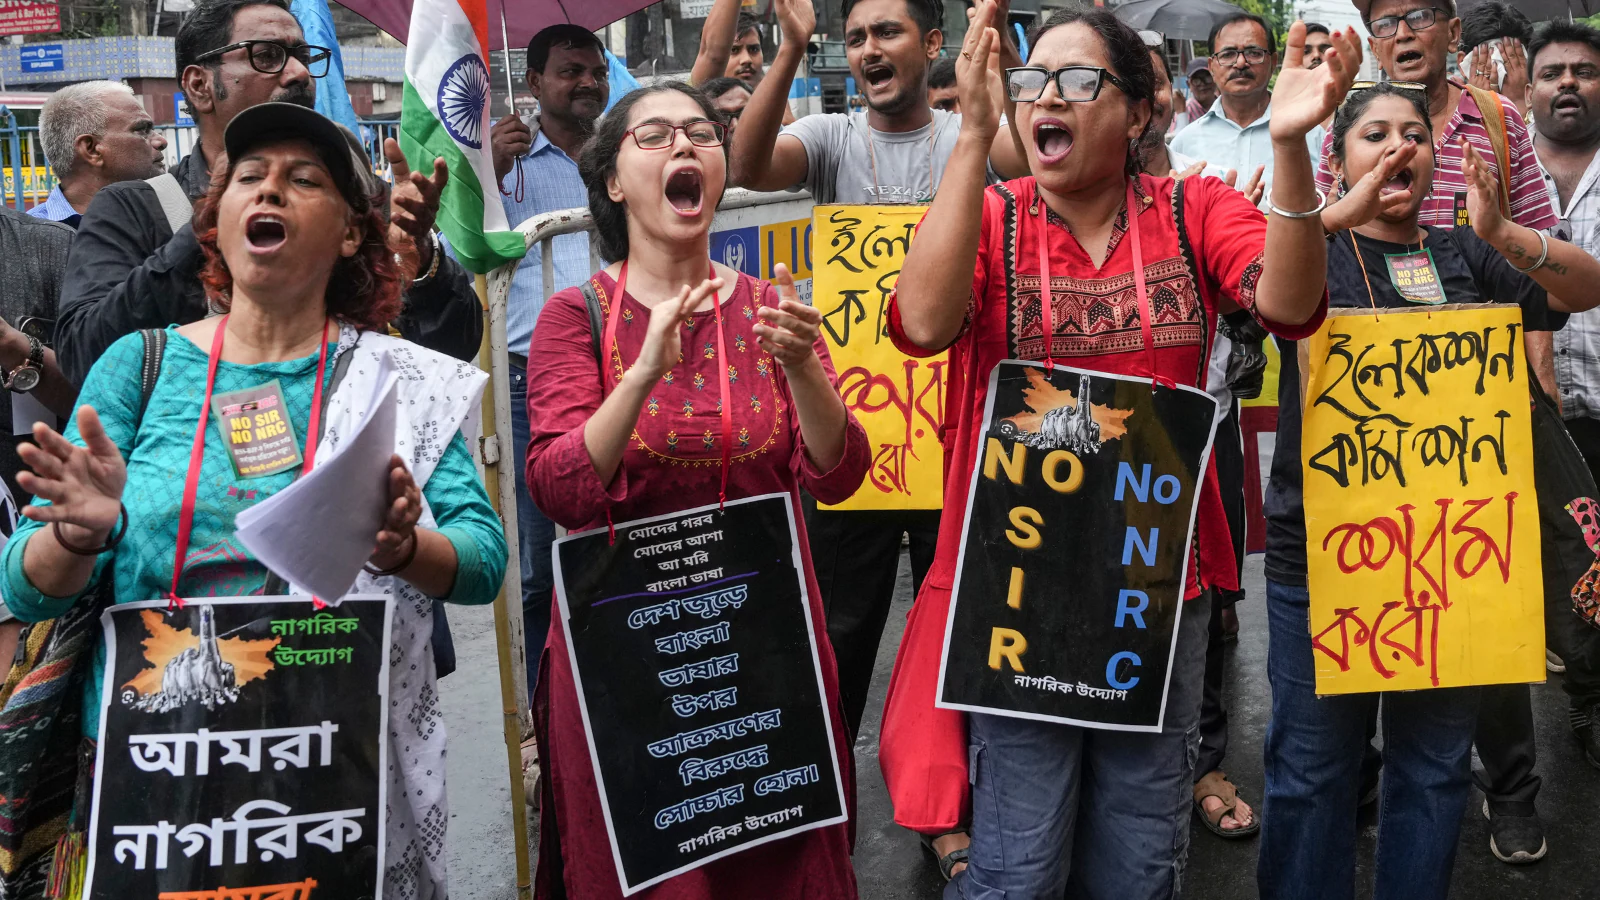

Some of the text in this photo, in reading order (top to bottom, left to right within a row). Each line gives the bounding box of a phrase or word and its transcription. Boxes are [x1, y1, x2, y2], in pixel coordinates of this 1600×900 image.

[863, 185, 926, 199] TEXAS
[827, 210, 916, 273] ইলে
[1397, 266, 1431, 279] NO SIR
[1397, 274, 1435, 286] NO NRC
[230, 409, 280, 431] NO SIR
[230, 420, 287, 444] NO NRC
[983, 437, 1085, 494] NO
[1114, 461, 1182, 505] No
[628, 513, 714, 541] মোদের গরব
[633, 530, 724, 559] মোদের আশা
[658, 550, 710, 571] আ মরি
[645, 566, 724, 593] বাংলা ভাষা
[270, 612, 359, 636] নাগরিক
[627, 599, 680, 629] দেশ
[654, 621, 731, 655] বাংলা
[274, 644, 354, 666] উদ্যোগ
[658, 652, 739, 687] ভাষার
[671, 686, 738, 718] উপর
[1014, 674, 1128, 701] নাগরিক উদ্যোগ
[647, 708, 781, 758] আক্রমণের
[128, 720, 339, 777] আমরা
[678, 744, 769, 786] বিরুদ্ধে
[654, 783, 745, 830] সোচ্চার
[113, 799, 366, 870] নাগরিক
[677, 804, 804, 854] নাগরিক উদ্যোগ
